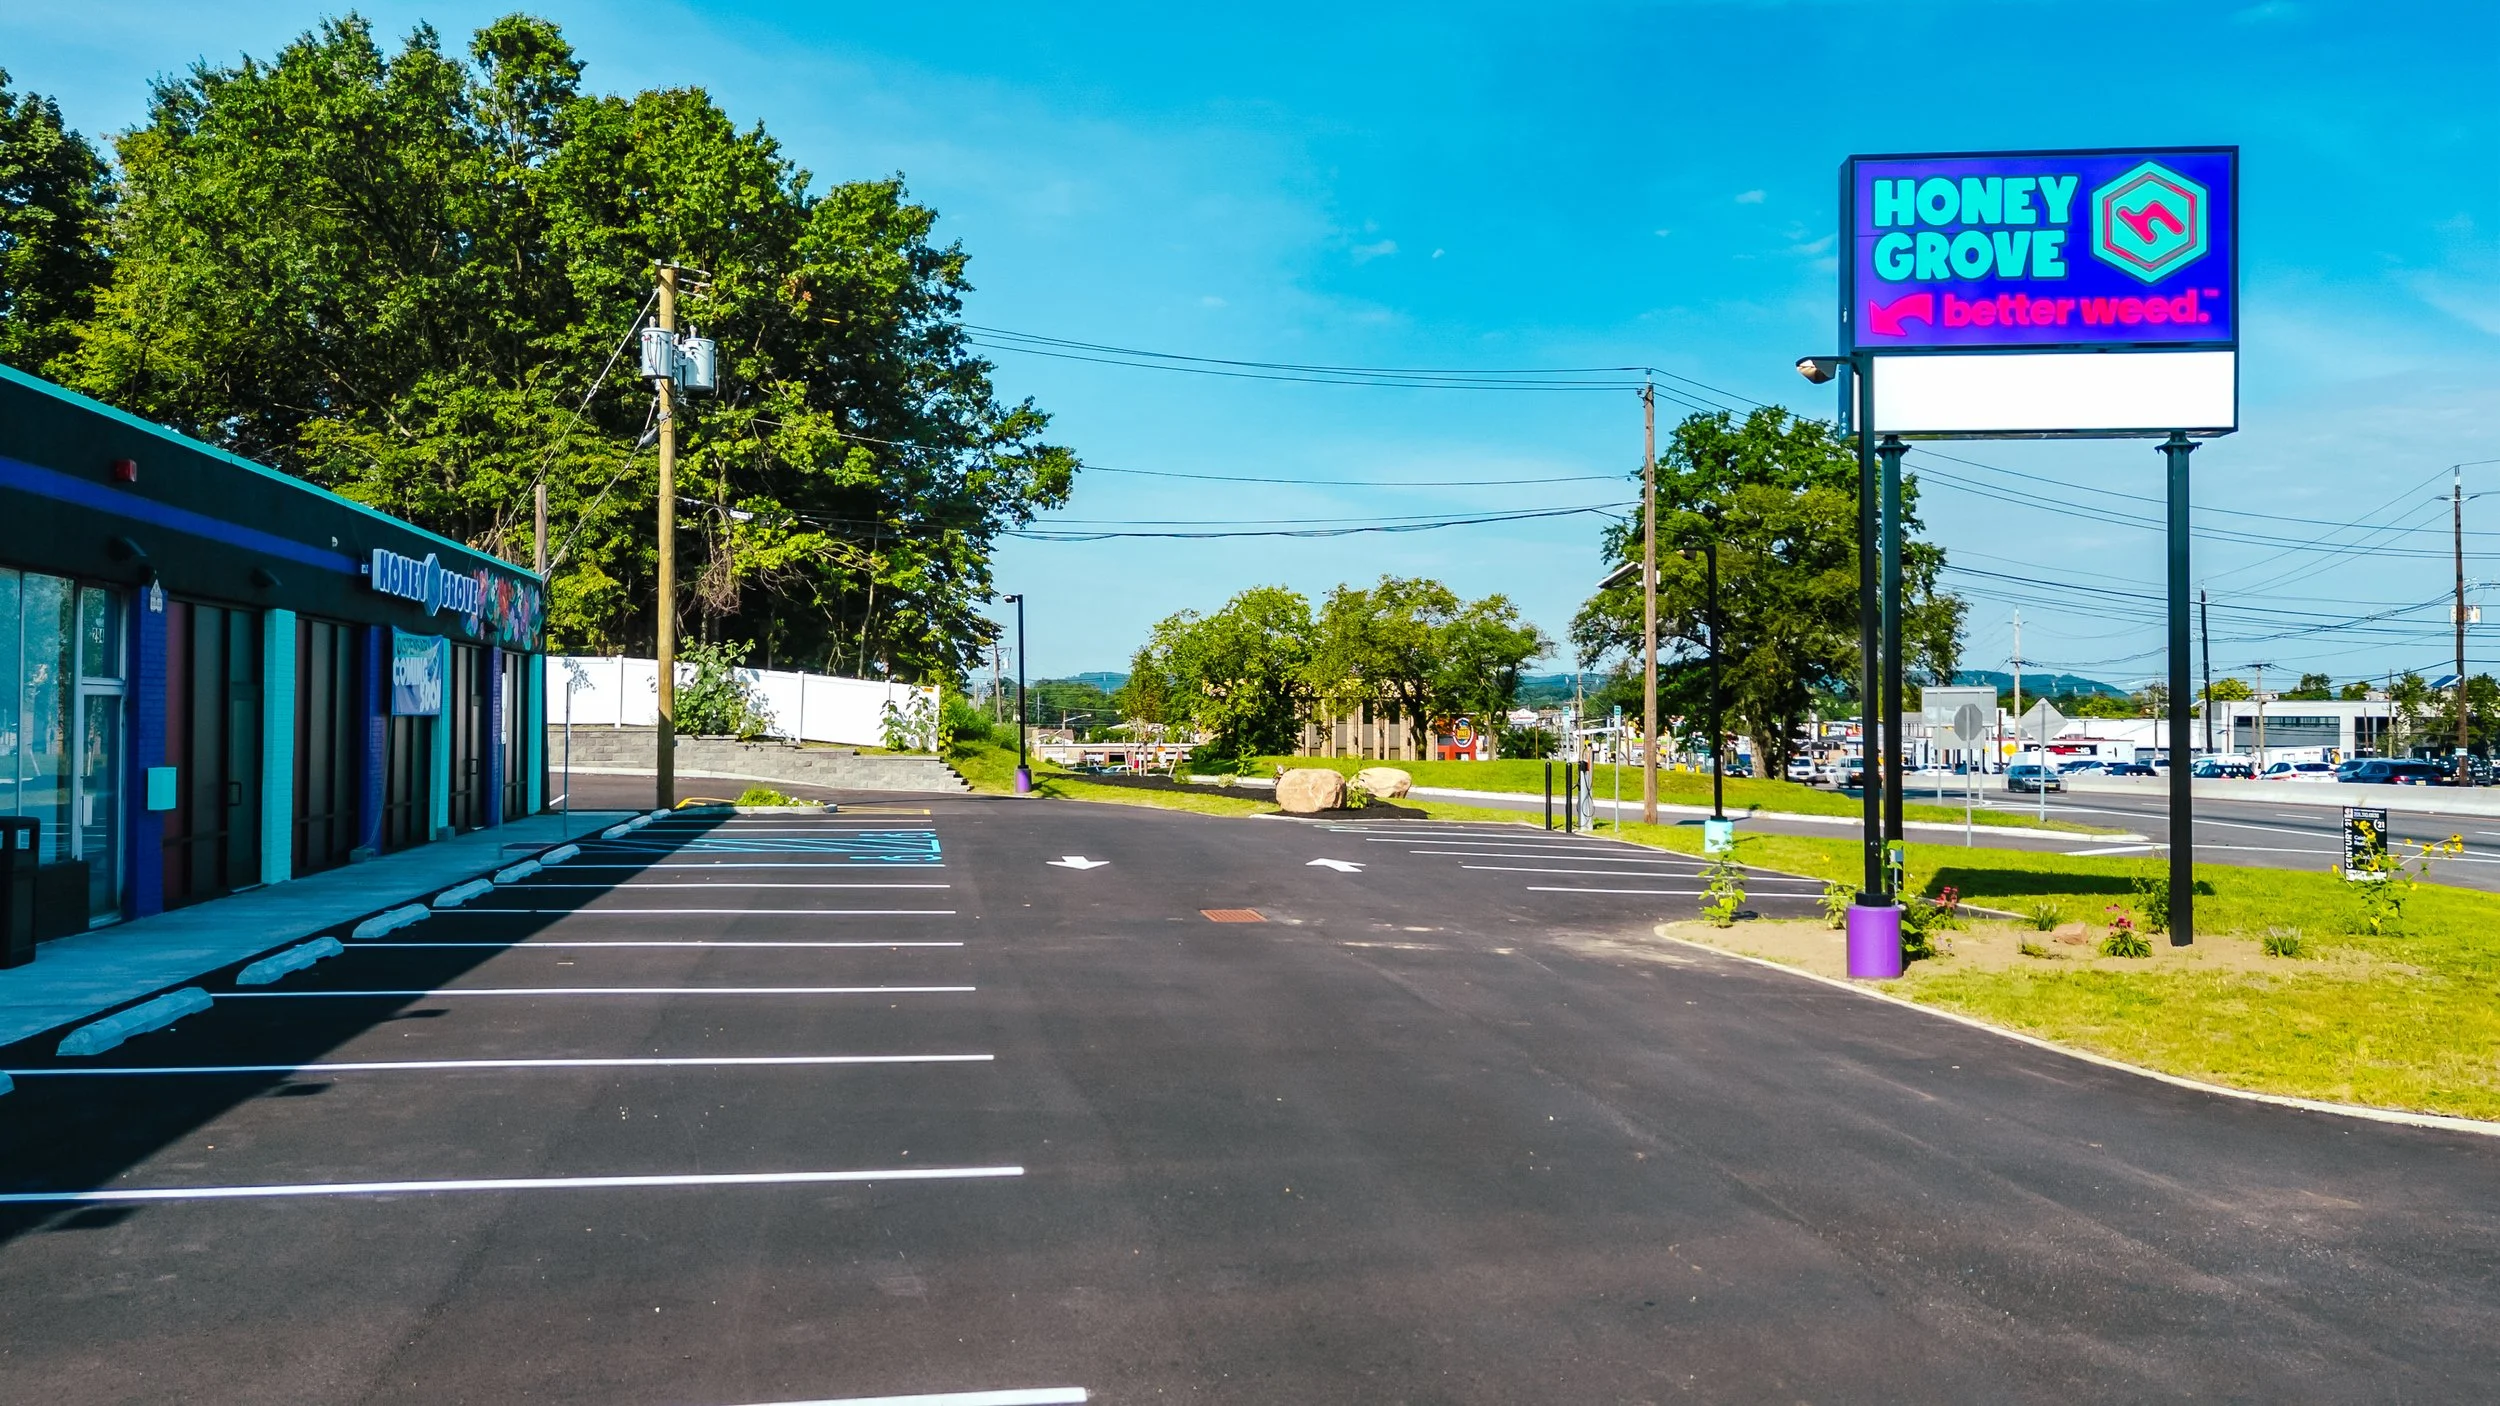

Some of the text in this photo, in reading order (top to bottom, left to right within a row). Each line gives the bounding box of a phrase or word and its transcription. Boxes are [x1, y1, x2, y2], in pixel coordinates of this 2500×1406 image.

[1873, 175, 2078, 227] HONEY
[1873, 230, 2066, 281] GROVE
[1943, 293, 2076, 327] better
[2080, 289, 2210, 325] weed.
[376, 549, 479, 616] HONEY GROVE
[392, 656, 429, 687] COMING
[419, 679, 442, 713] SOON
[2345, 819, 2353, 868] CENTURY 21
